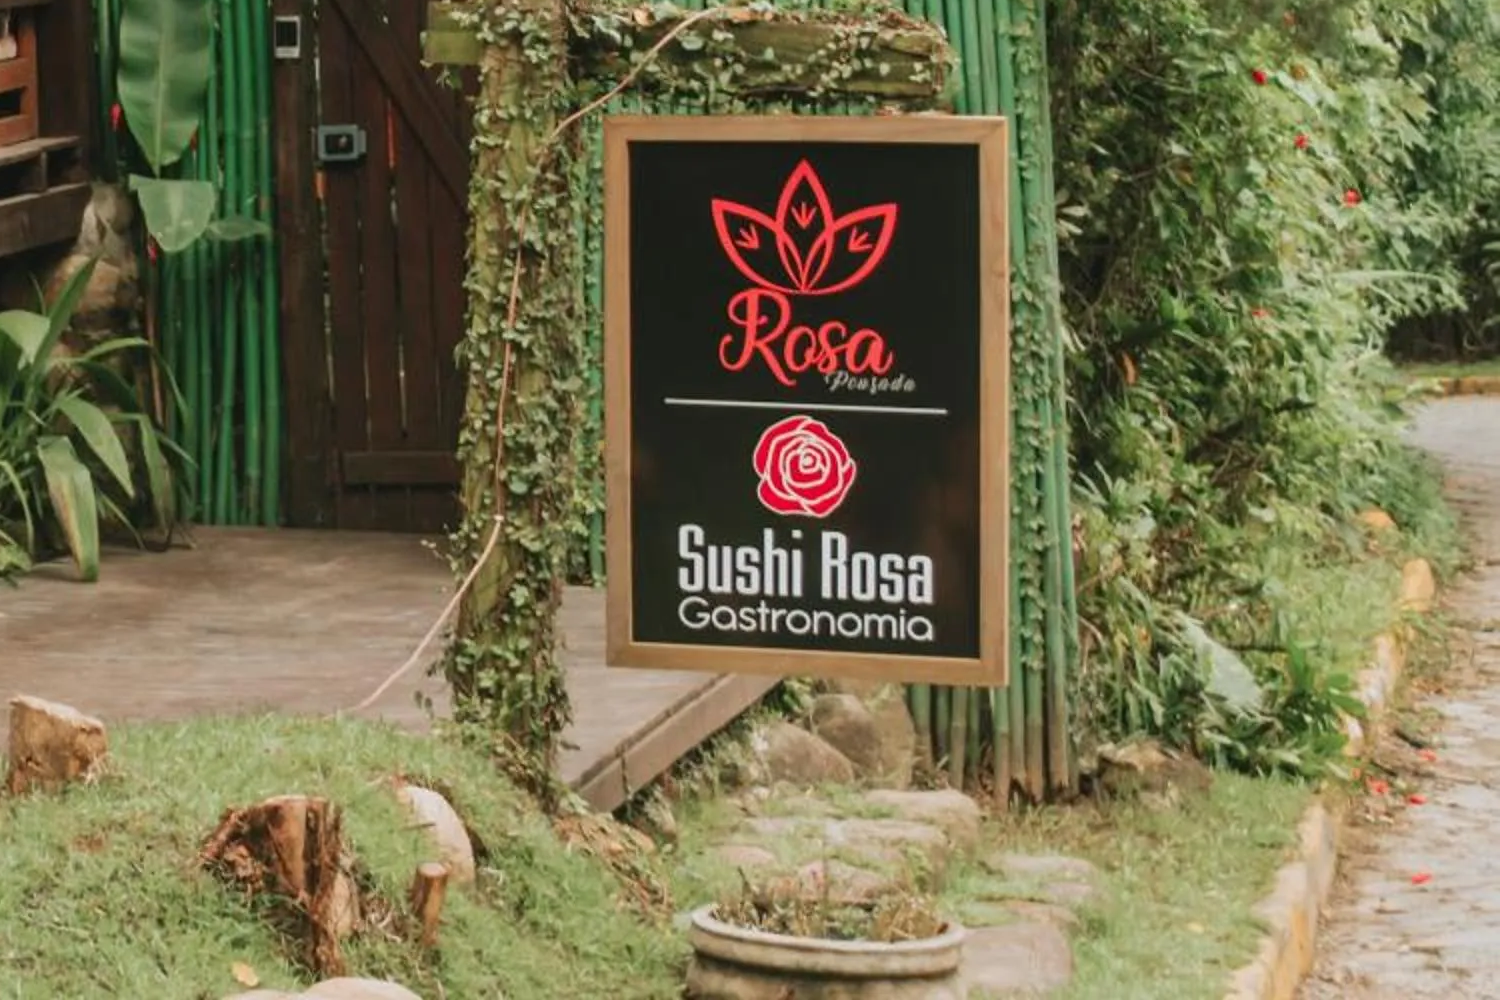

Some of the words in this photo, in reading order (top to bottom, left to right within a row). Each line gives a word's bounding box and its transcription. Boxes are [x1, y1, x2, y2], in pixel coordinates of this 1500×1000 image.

[719, 288, 894, 386] Rosa
[823, 371, 916, 394] Pousada
[678, 523, 802, 597] Sushi
[821, 530, 934, 604] Rosa
[678, 597, 934, 641] Gastronomia
